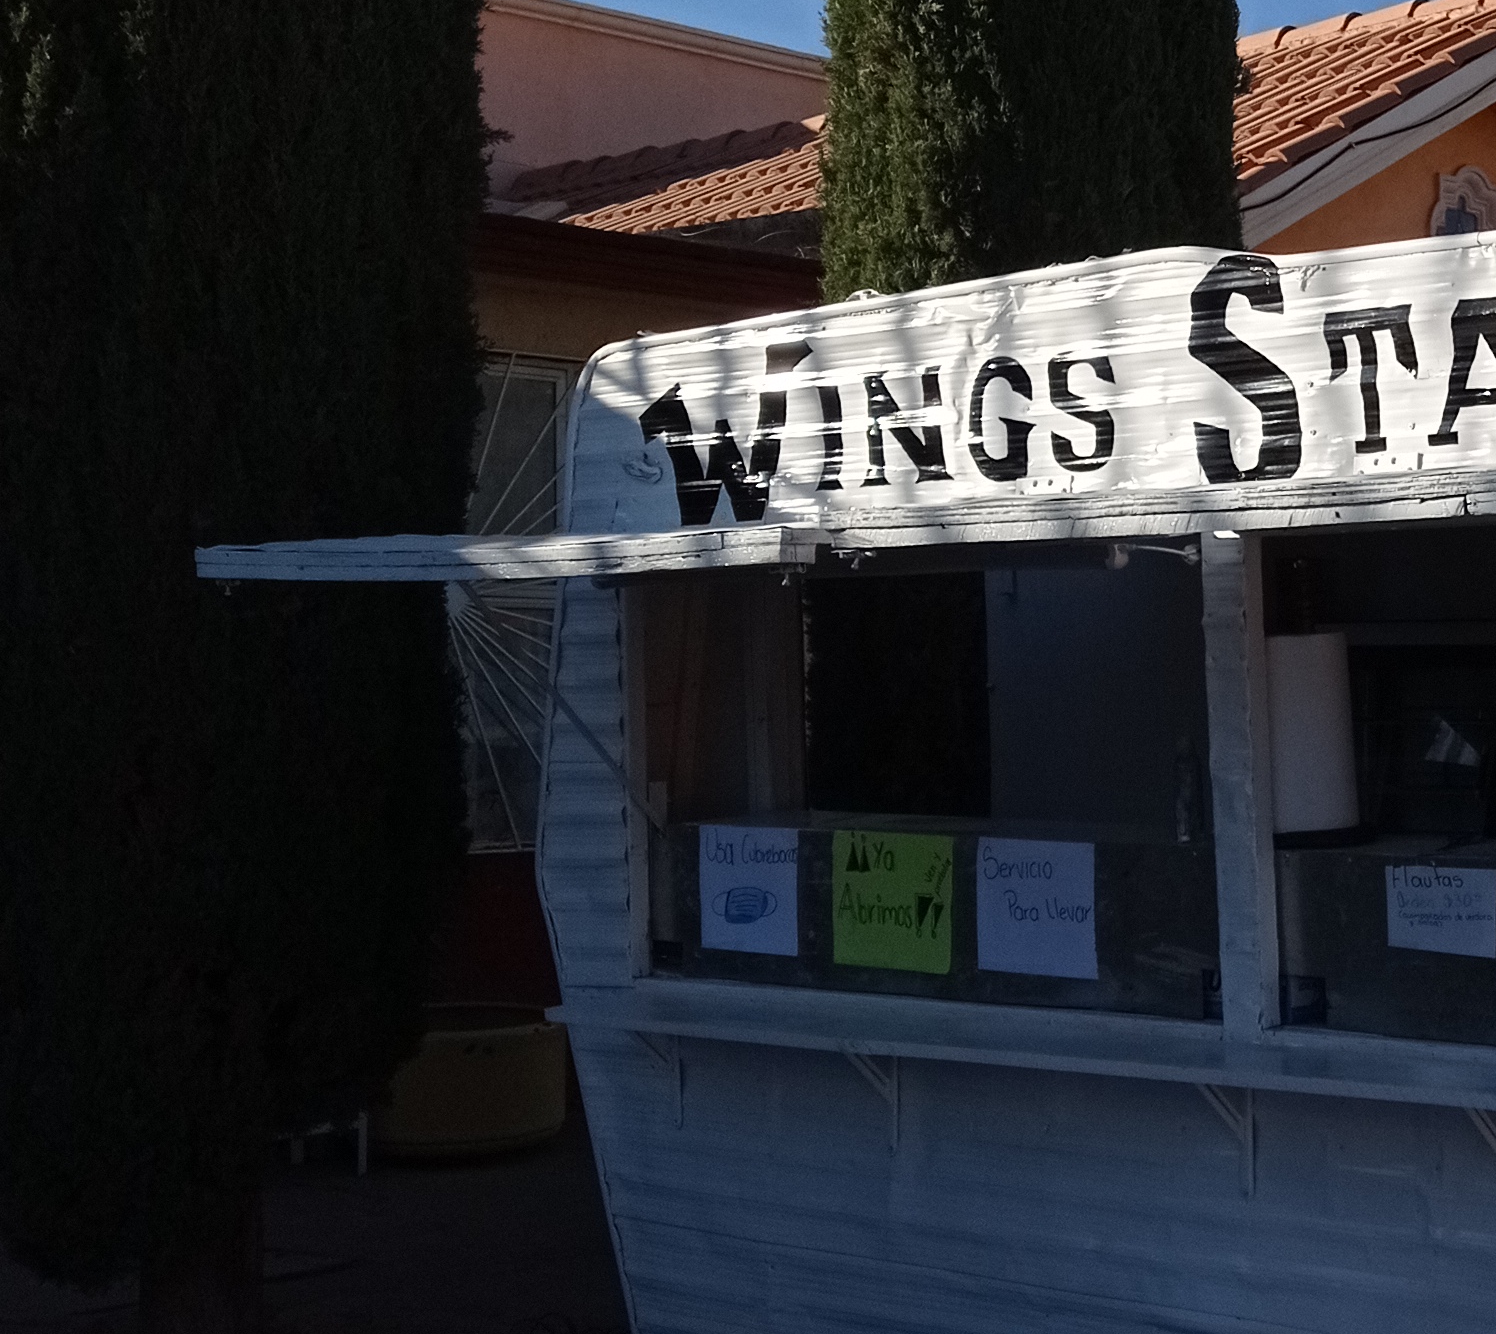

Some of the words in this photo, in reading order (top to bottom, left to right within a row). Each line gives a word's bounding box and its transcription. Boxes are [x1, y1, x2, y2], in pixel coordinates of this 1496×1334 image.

[638, 339, 1118, 526] WINGS
[706, 827, 735, 866] Usa
[983, 845, 1053, 880] Servicio
[1392, 866, 1464, 888] Flautas
[1003, 889, 1040, 922] Para
